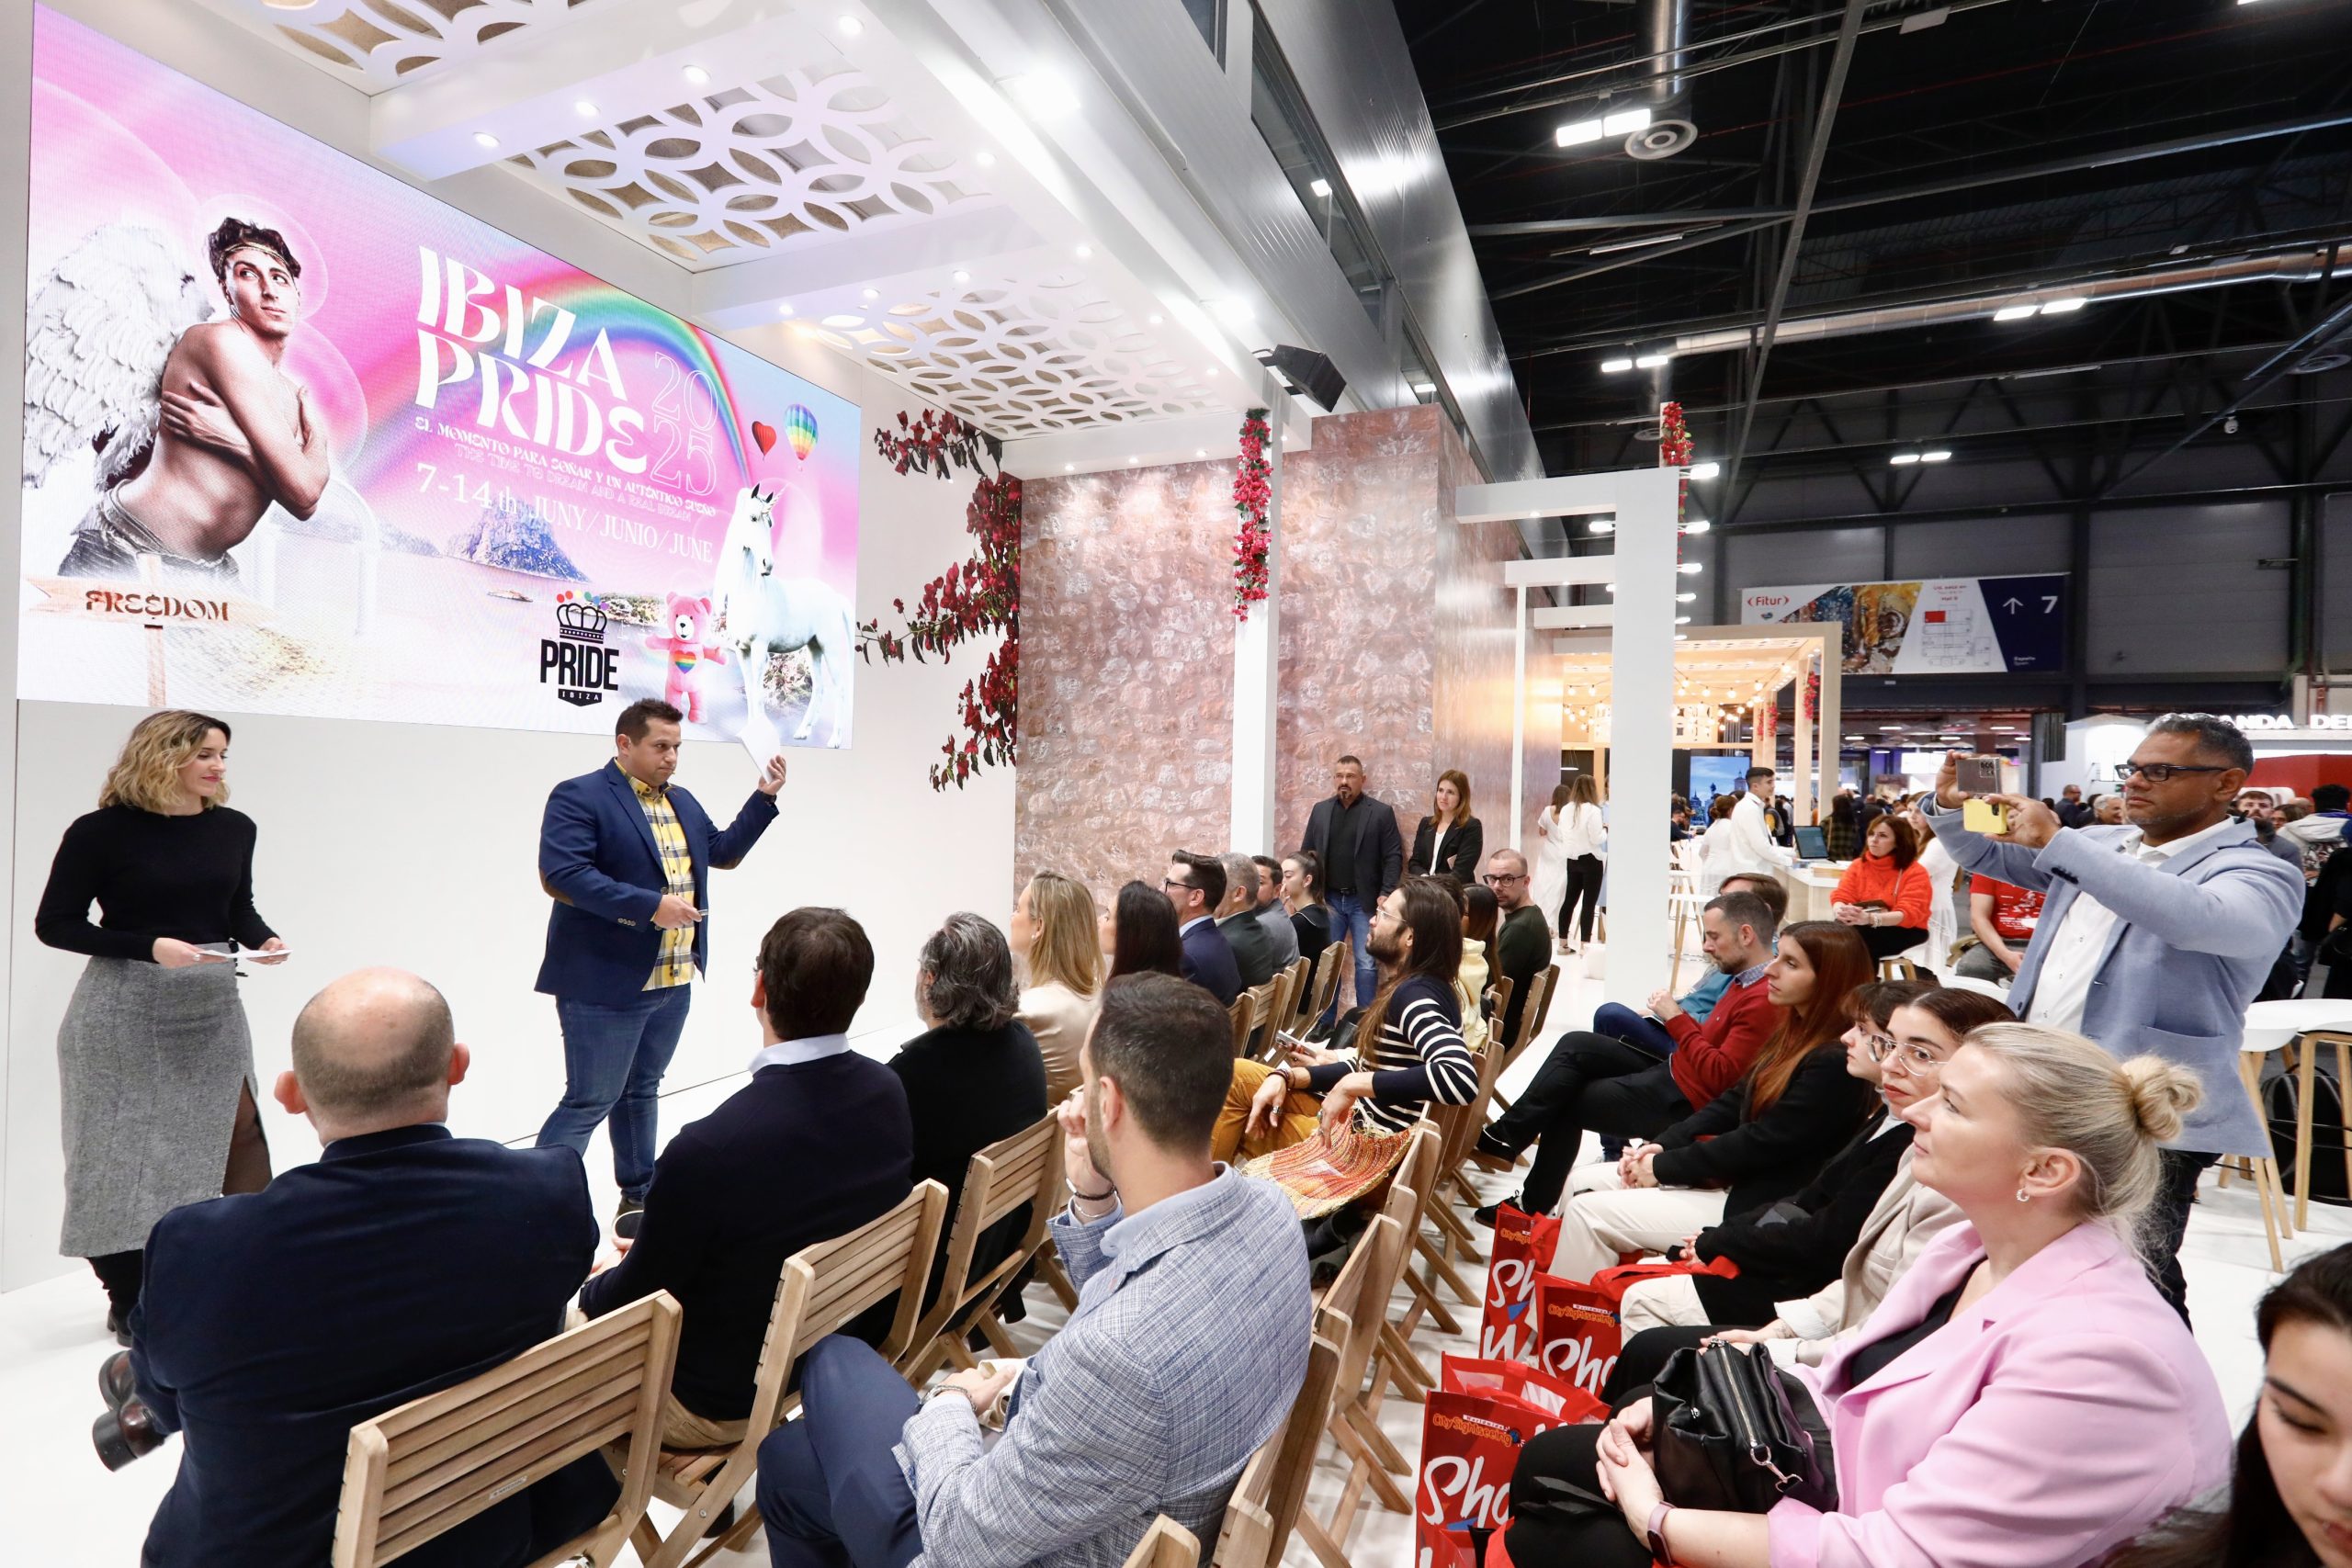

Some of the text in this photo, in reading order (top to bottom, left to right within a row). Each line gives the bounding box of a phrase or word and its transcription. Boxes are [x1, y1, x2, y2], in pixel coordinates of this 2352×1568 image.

[417, 245, 628, 401] IBIZA
[415, 329, 647, 474] PRIDE
[651, 351, 718, 432] 20
[415, 416, 433, 433] EL
[437, 422, 510, 455] MOMENTO
[514, 446, 548, 468] PARA
[551, 457, 592, 481] SOÑAR
[596, 469, 604, 482] Y
[606, 474, 622, 490] UN
[650, 414, 717, 496] 25
[85, 590, 230, 622] FREEDOM
[1756, 595, 1782, 606] Fitur
[2041, 595, 2059, 615] 7
[540, 638, 620, 692] PRIDE
[561, 691, 599, 700] IBIZA
